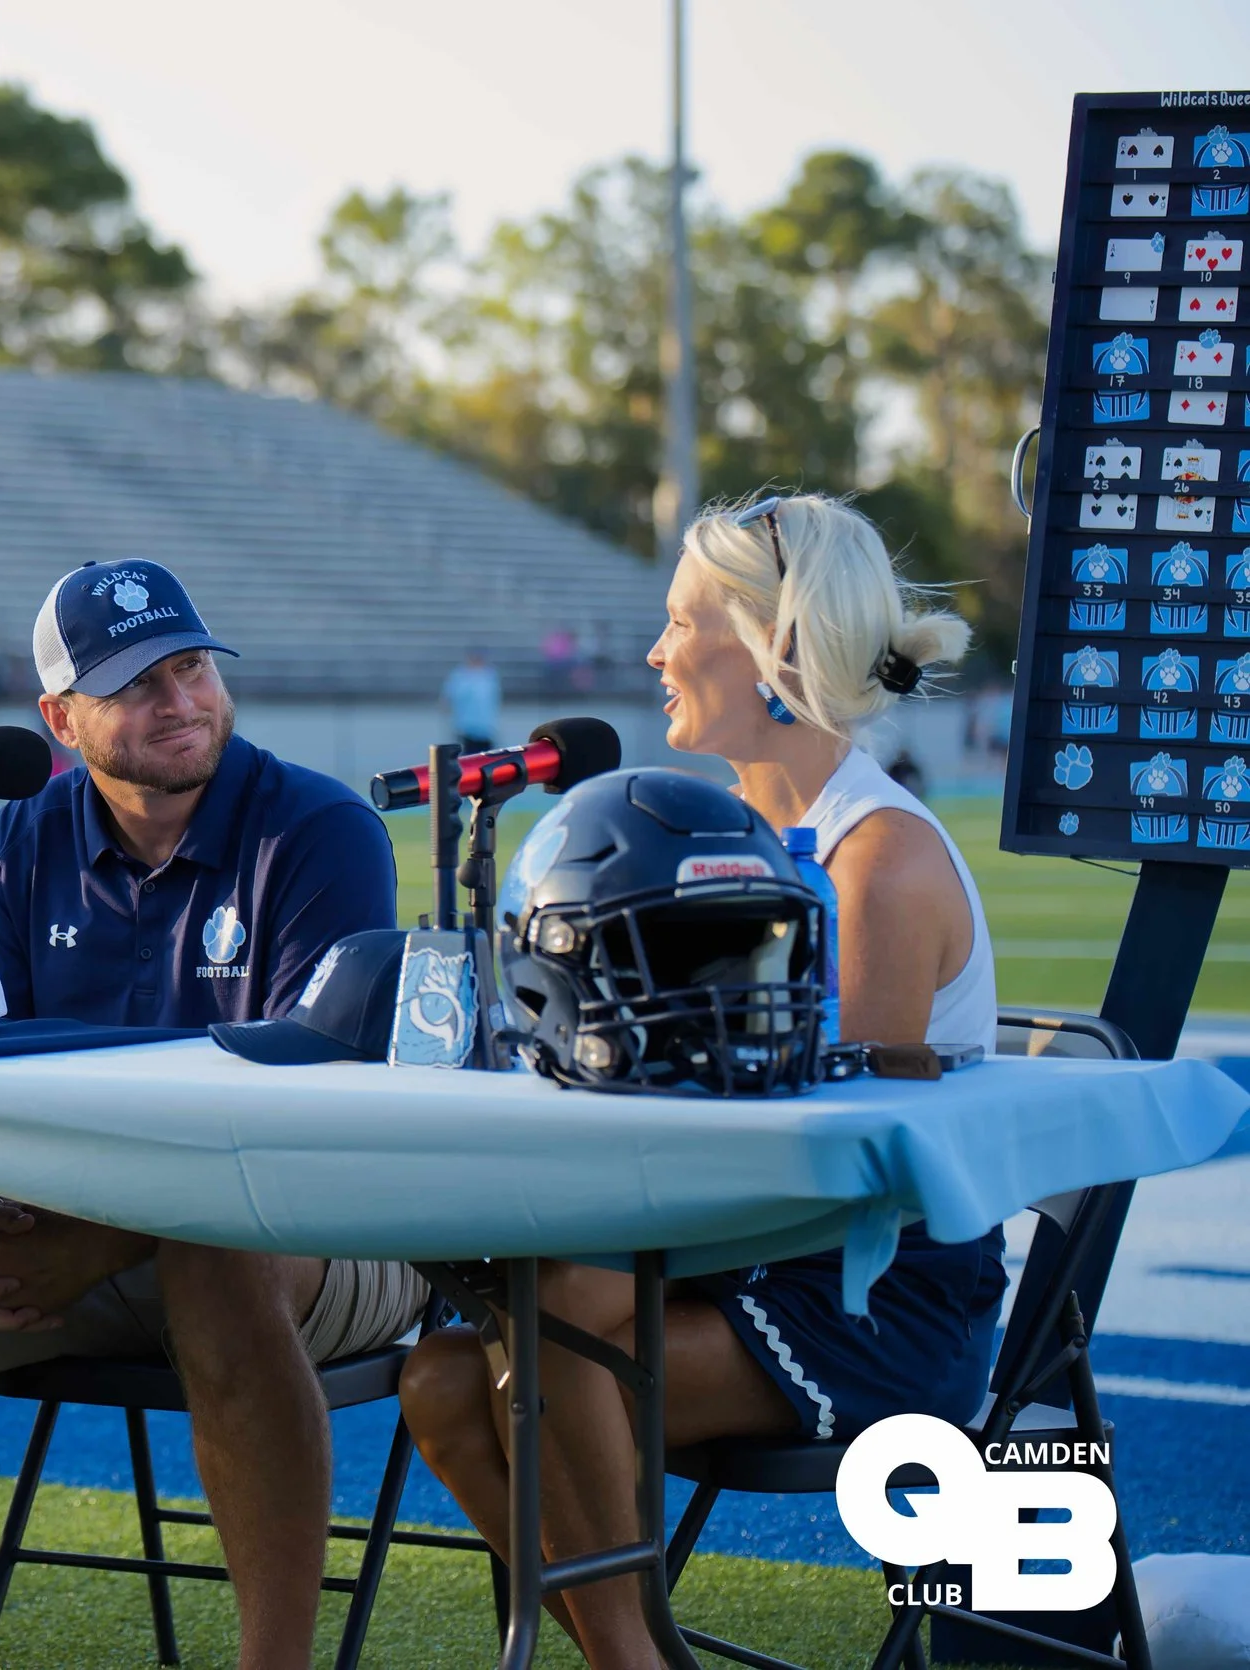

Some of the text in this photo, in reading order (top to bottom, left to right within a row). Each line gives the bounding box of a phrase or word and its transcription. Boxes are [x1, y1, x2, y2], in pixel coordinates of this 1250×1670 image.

[1133, 169, 1137, 181] 1
[1213, 169, 1221, 180] 2
[1124, 272, 1131, 284] 9
[1200, 271, 1212, 282] 10
[1110, 375, 1125, 387] 17
[1188, 376, 1203, 389] 18
[1093, 480, 1109, 490] 25
[1174, 482, 1190, 493] 26
[91, 570, 148, 597] WILDCAT
[1083, 584, 1103, 597] 33
[1163, 588, 1180, 600] 34
[107, 606, 179, 638] FOOTBALL
[1072, 687, 1085, 700] 41
[1153, 691, 1168, 703] 42
[1224, 695, 1241, 708] 43
[1140, 796, 1155, 809] 49
[1215, 802, 1230, 813] 50
